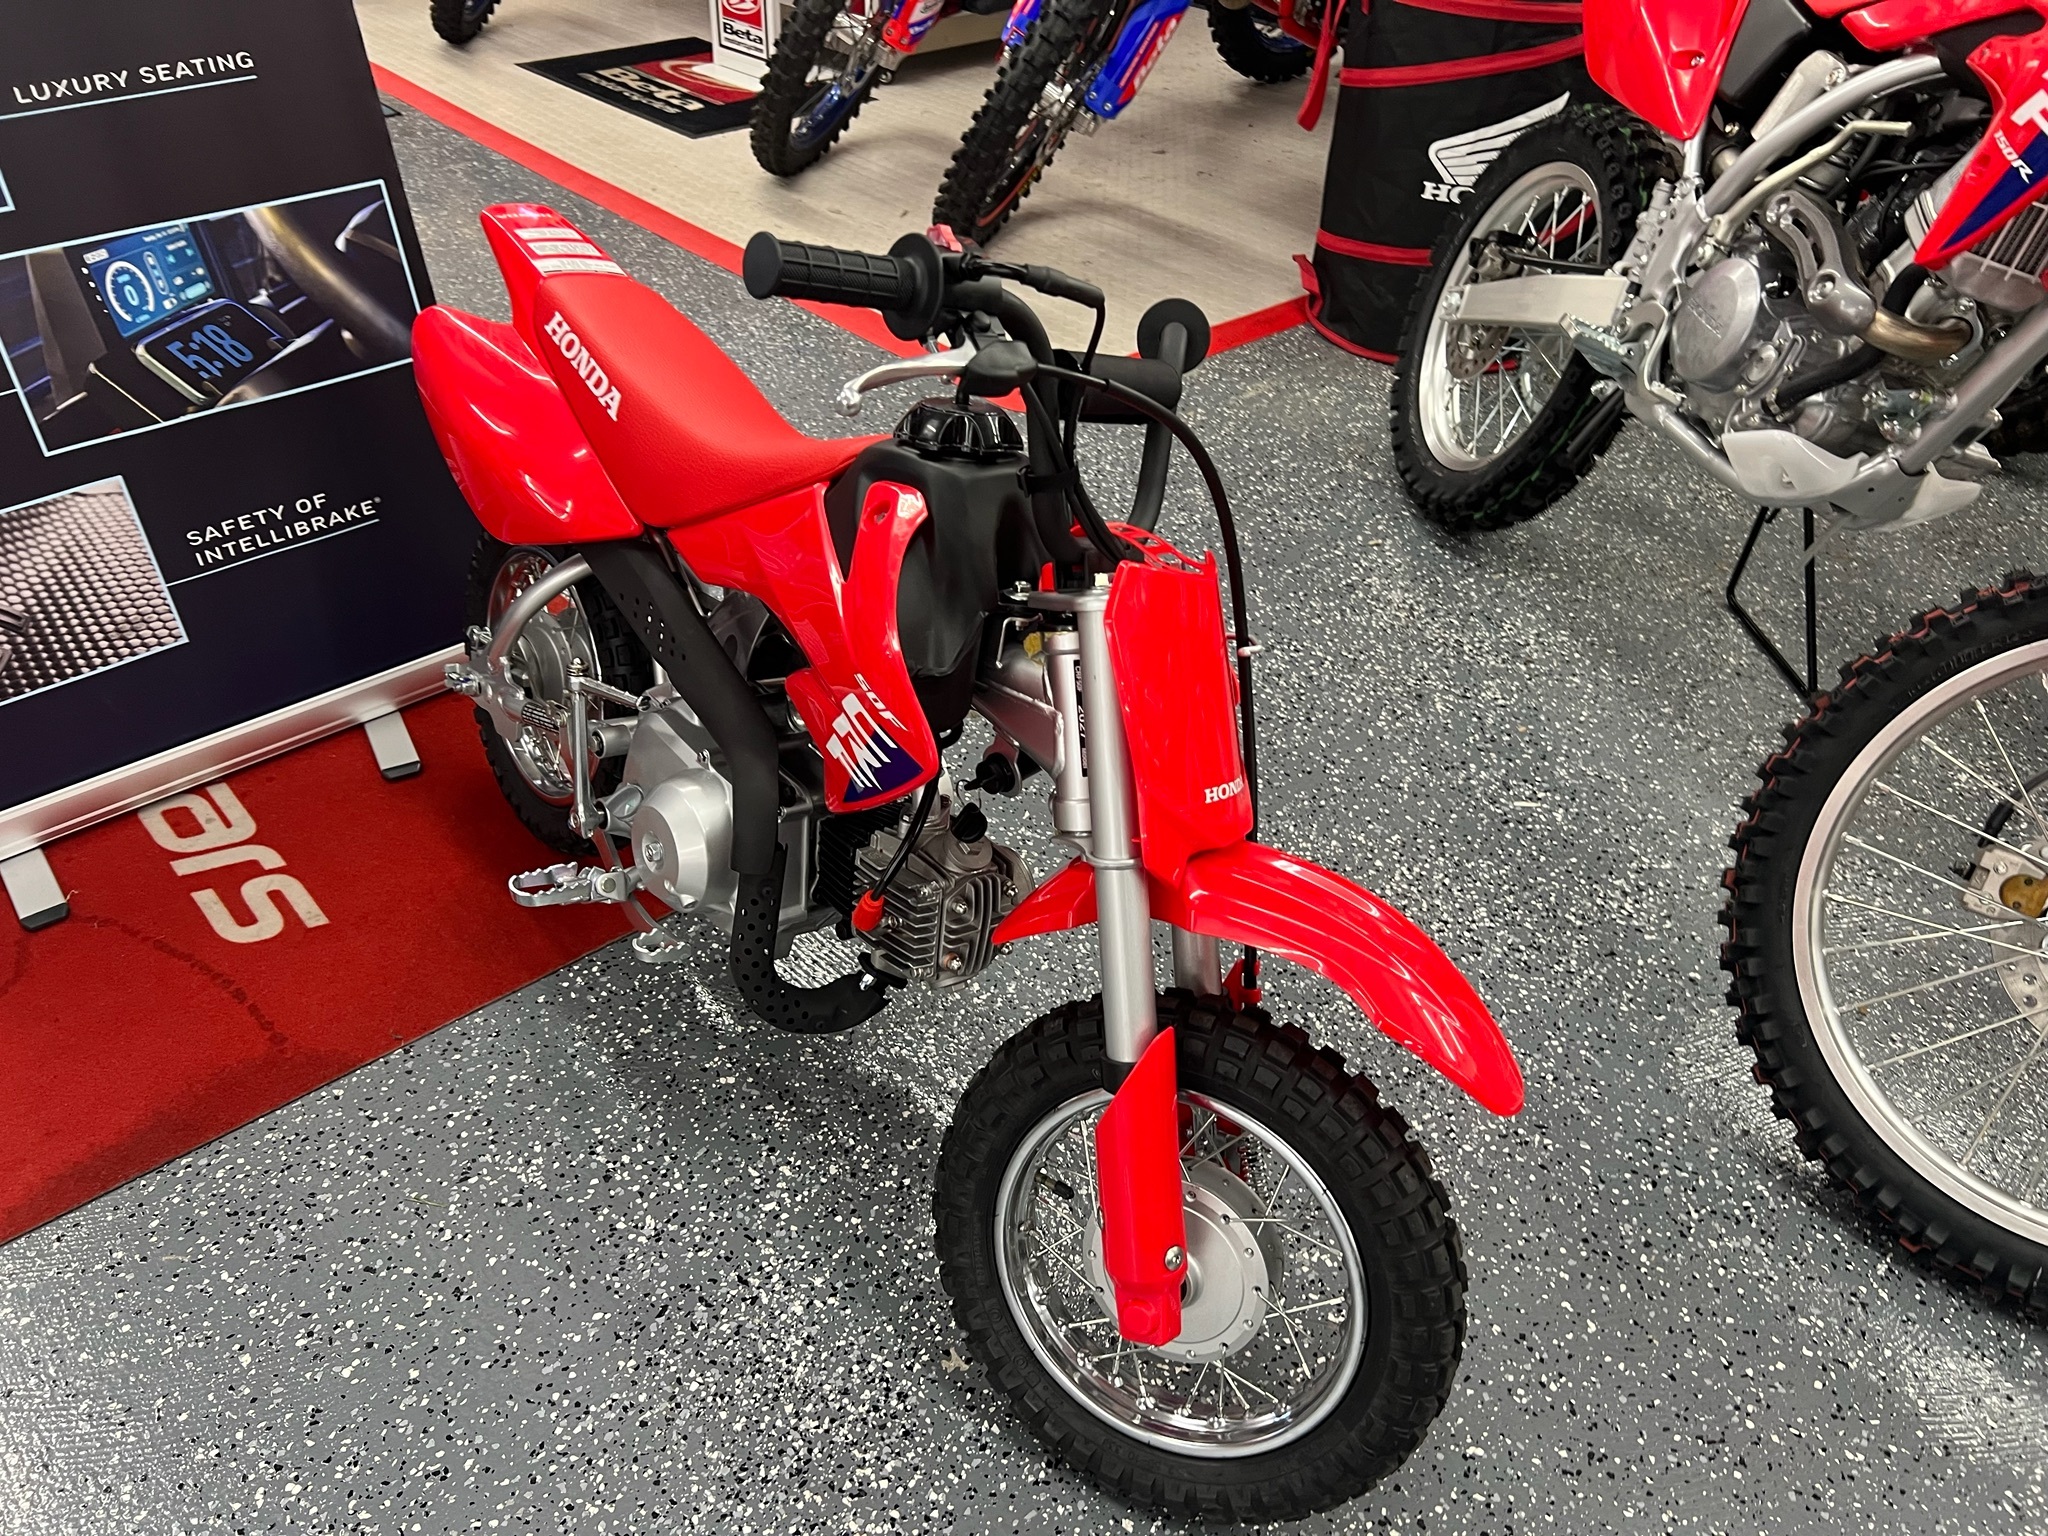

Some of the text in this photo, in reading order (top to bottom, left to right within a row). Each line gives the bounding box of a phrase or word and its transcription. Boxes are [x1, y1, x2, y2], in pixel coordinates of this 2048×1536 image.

[721, 21, 764, 45] Beta
[12, 51, 255, 104] LUXURY SEATING
[595, 67, 706, 112] Beta
[1993, 129, 2034, 184] 150R
[165, 324, 254, 380] 5:18
[543, 311, 622, 422] HONDA
[185, 493, 327, 546] SAFETY OF
[853, 673, 909, 732] 50F
